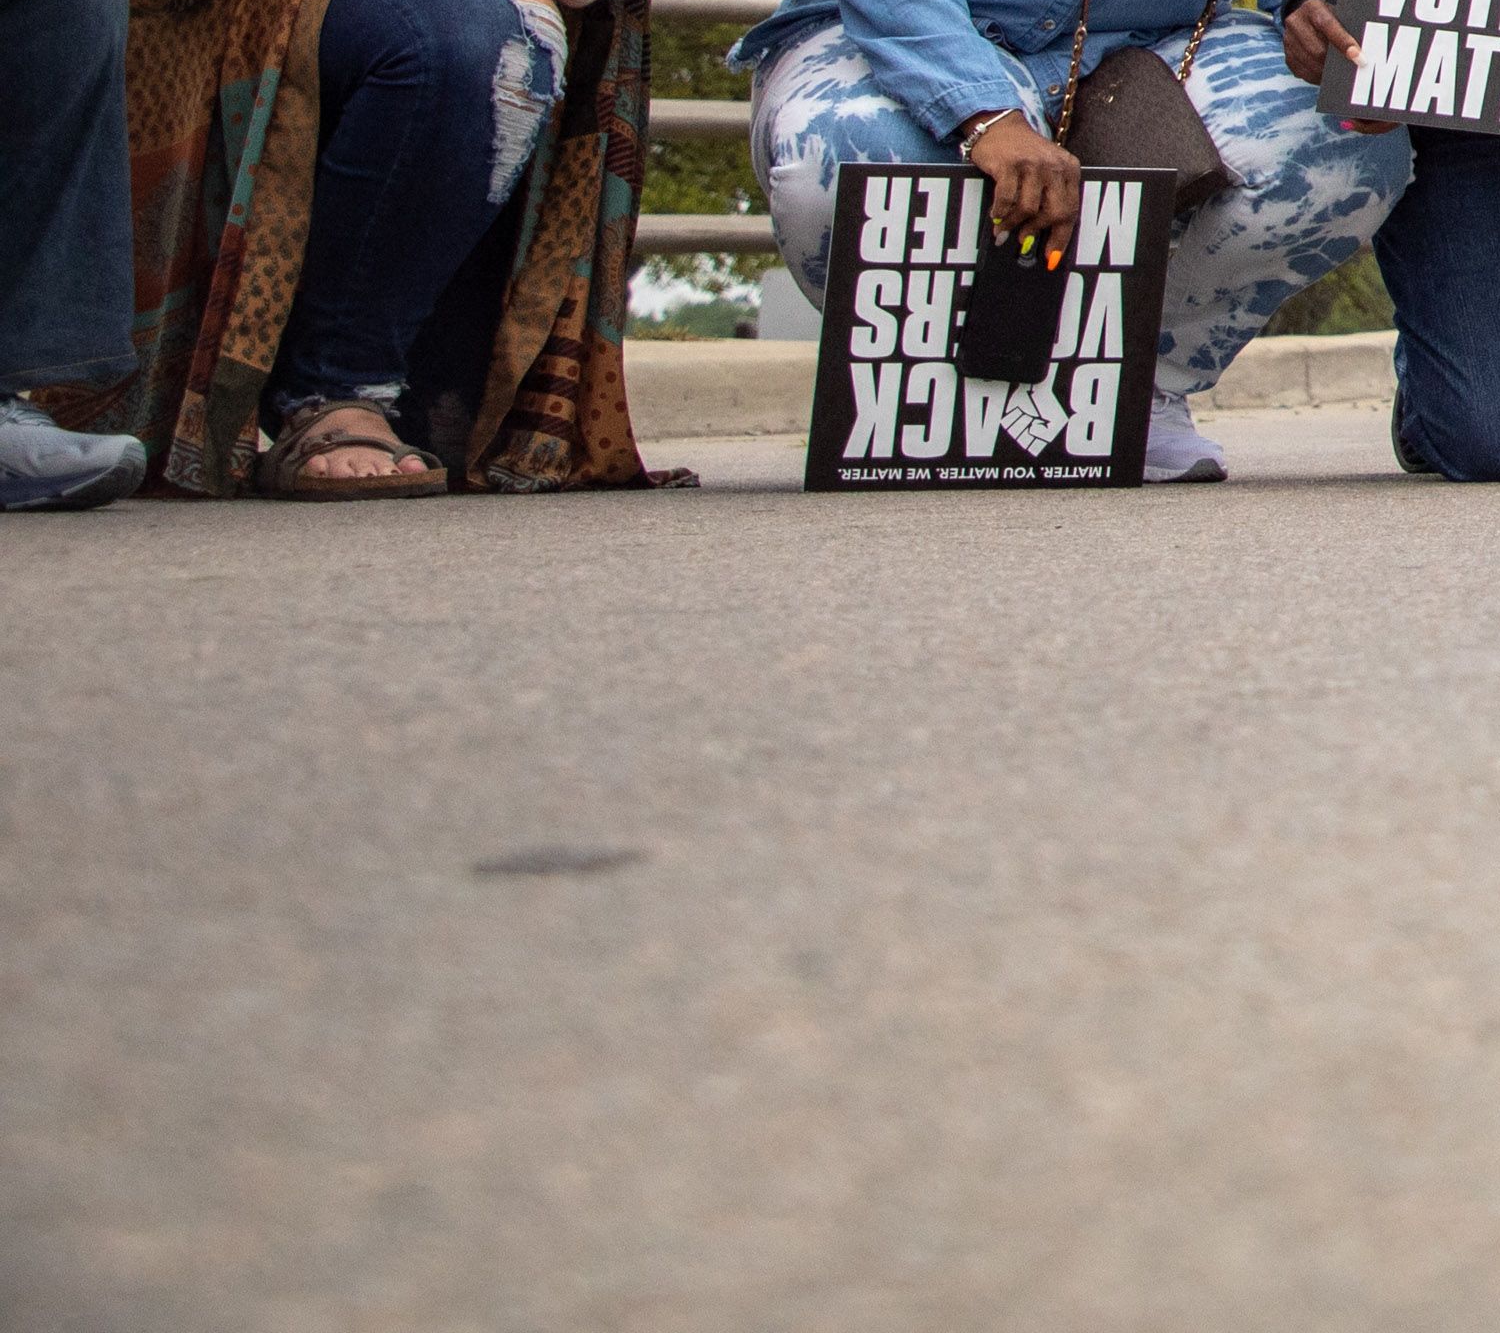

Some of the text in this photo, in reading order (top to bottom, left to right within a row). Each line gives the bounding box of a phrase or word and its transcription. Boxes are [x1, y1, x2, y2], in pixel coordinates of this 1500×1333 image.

[838, 466, 1111, 480] I MATTER. YOU MATTER. WE MATTER.
